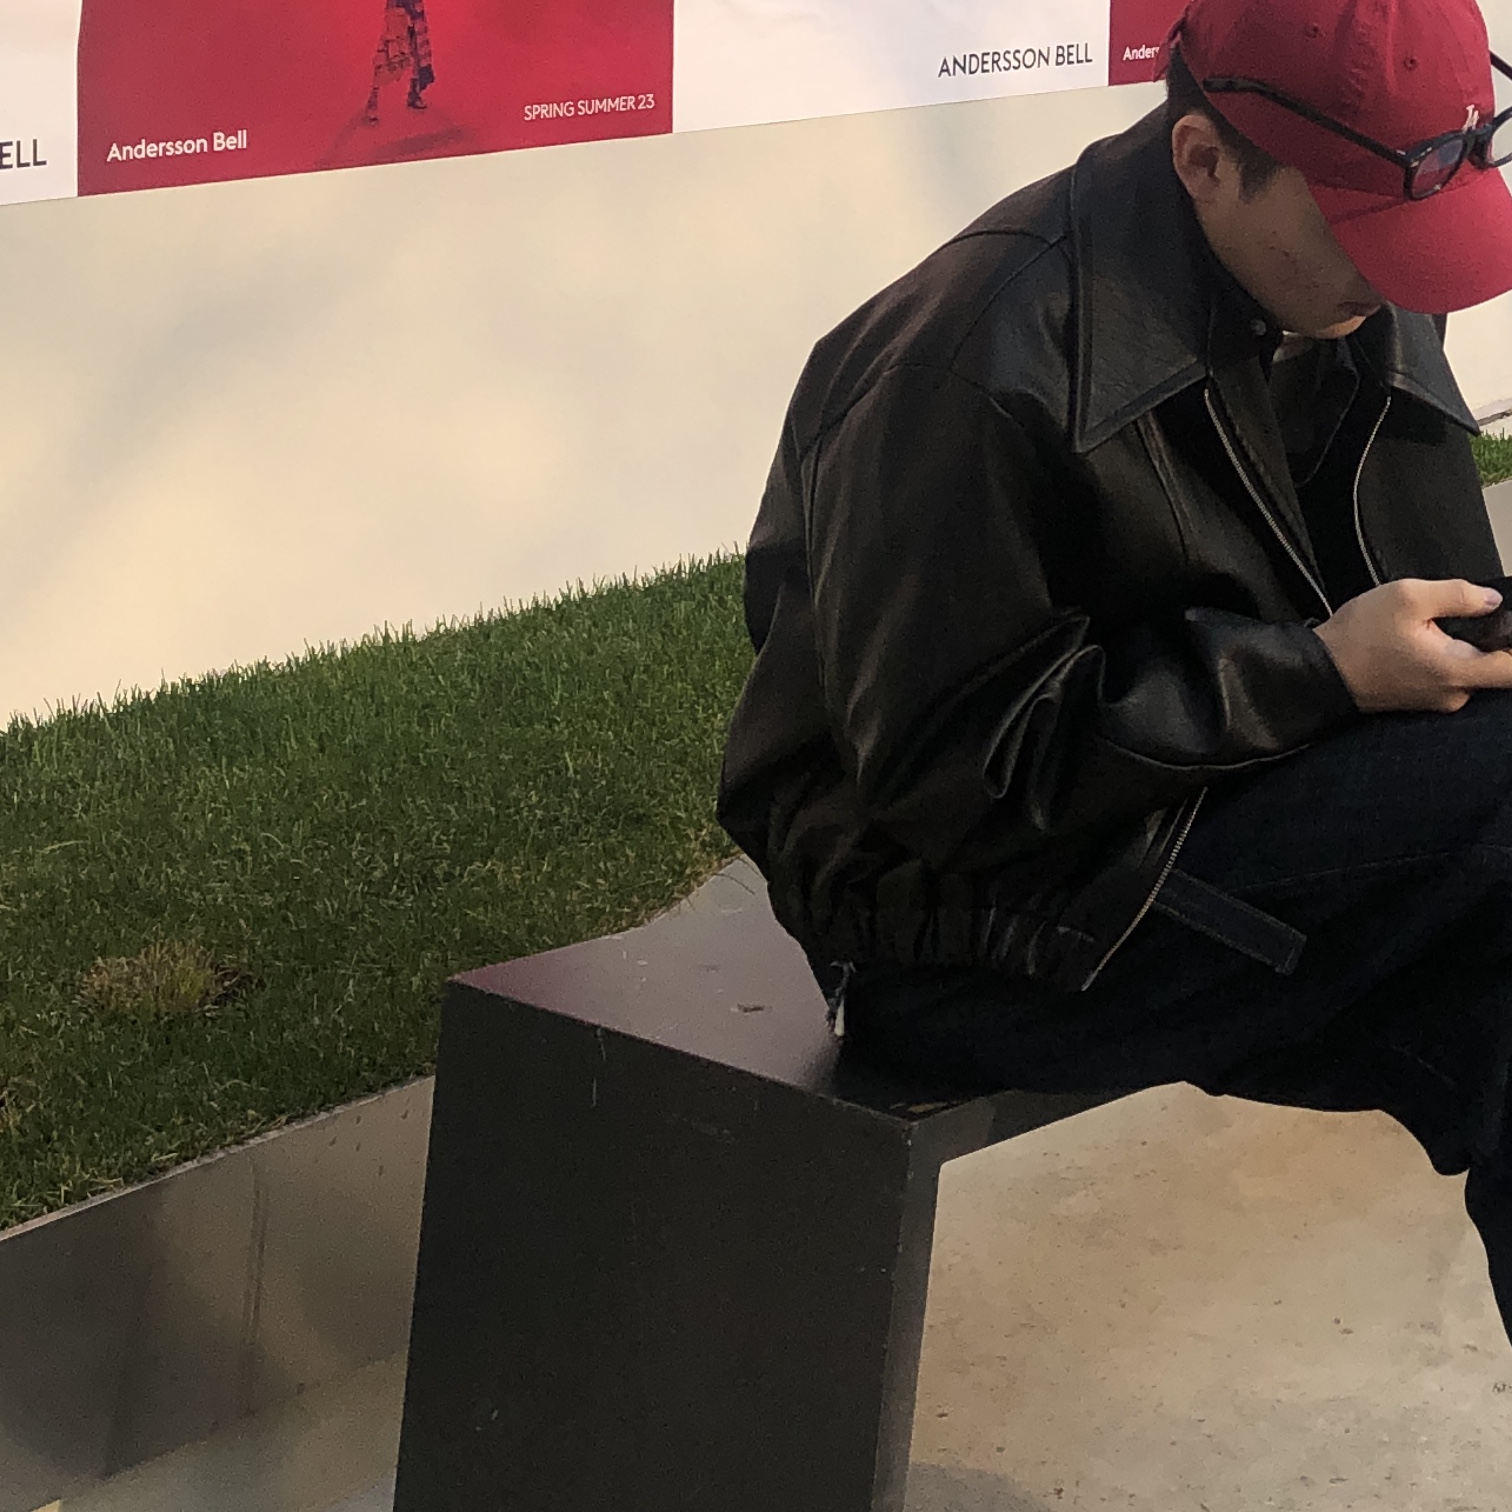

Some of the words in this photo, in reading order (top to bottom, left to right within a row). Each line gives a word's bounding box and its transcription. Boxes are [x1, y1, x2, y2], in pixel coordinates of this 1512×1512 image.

[938, 46, 1051, 78] ANDERSSON
[1055, 42, 1093, 66] BELL
[524, 101, 575, 121] SPRING
[577, 96, 636, 115] SUMMER
[637, 93, 655, 110] 23
[106, 138, 208, 162] Andersson
[212, 129, 247, 151] Bell
